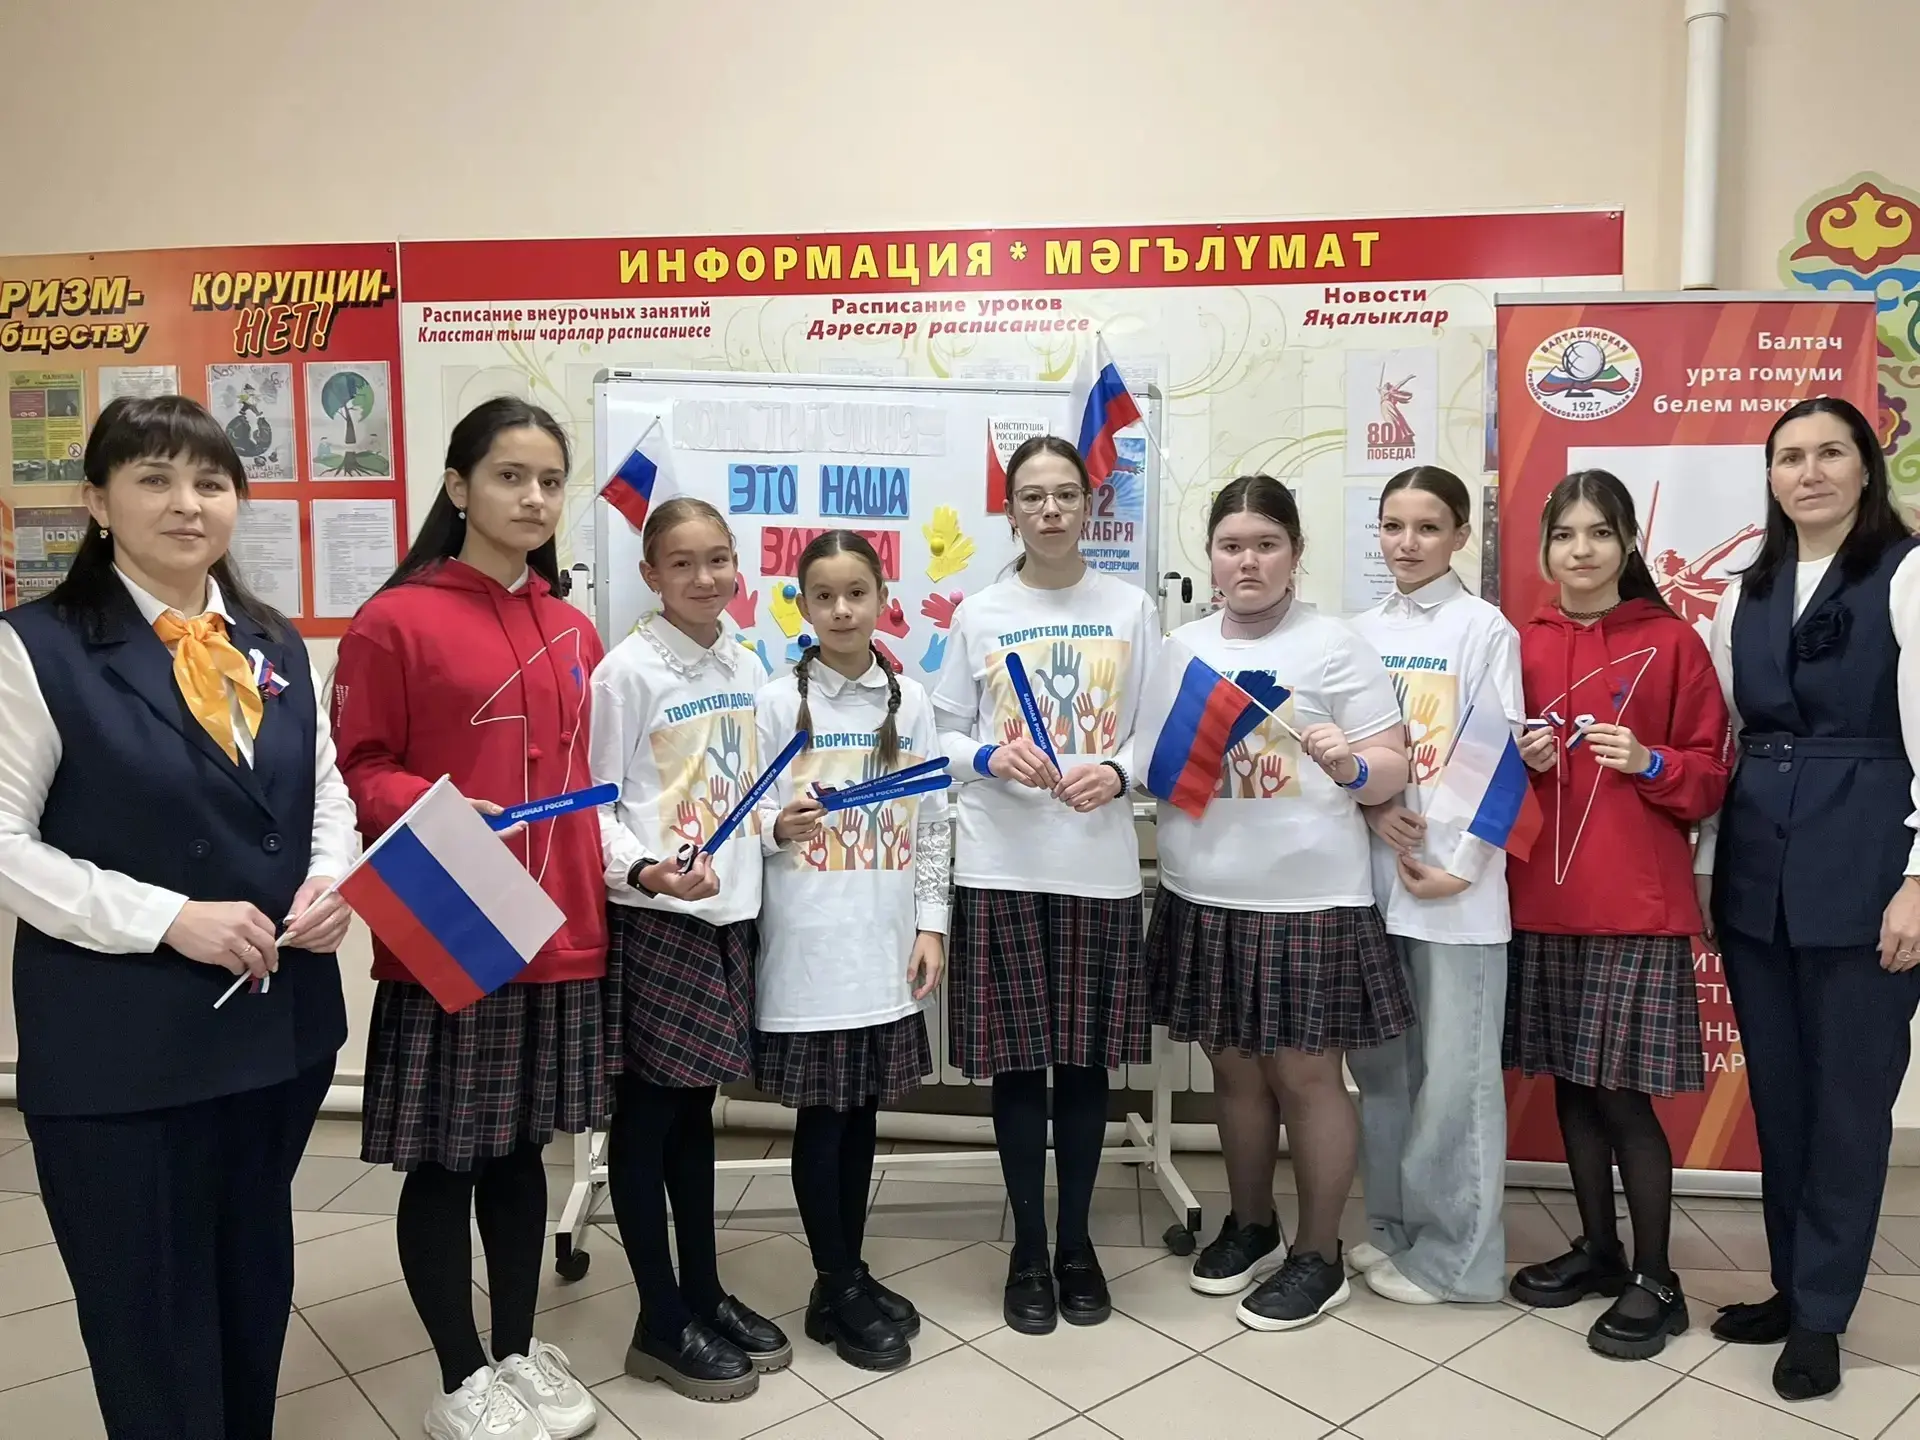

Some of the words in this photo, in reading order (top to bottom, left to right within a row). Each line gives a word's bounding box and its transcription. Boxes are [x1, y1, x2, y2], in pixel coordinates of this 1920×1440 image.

[618, 241, 993, 286] ИНФОРМАЦИЯ
[190, 269, 393, 308] КОРРУПЦИИ-
[1324, 287, 1427, 304] Новости
[422, 306, 523, 323] Расписание
[527, 304, 636, 325] внеурочных
[640, 301, 711, 319] занятий
[831, 297, 966, 315] Расписание
[977, 298, 1063, 316] уроков
[233, 301, 334, 354] НЕТ!
[806, 320, 918, 341] Дәресләр
[928, 317, 1090, 339] расписаниесе
[1303, 309, 1449, 329] Яңалыклар
[417, 327, 494, 343] Класстан
[496, 328, 536, 342] тыш
[539, 327, 605, 345] чаралар
[607, 325, 712, 344] расписаниесе
[1541, 330, 1629, 354] БАЛТАСИНСКАЯ
[1758, 331, 1842, 350] Балтач
[1686, 368, 1742, 387] урта
[1749, 367, 1842, 386] гомуми
[1572, 401, 1602, 412] 1927
[1653, 394, 1732, 413] белем
[994, 421, 1044, 431] КОНСТИТУЦИЯ
[1367, 422, 1394, 445] 80
[998, 442, 1020, 451] ФЕДЕР
[1367, 447, 1416, 461] ПОБЕДА!
[730, 464, 797, 515] ЭТО
[821, 464, 908, 516] НАША
[760, 526, 895, 580] ЗАА
[1099, 561, 1140, 571] ФЕДЕРАЦИИ
[998, 625, 1069, 647] ТВОРИТЕЛИ
[1071, 624, 1114, 639] ДОБРА
[1406, 656, 1448, 671] ДОБРА
[1023, 692, 1038, 722] ЕДИНАЯ
[753, 768, 777, 796] ЕДИНАЯ
[843, 793, 875, 803] ЕДИНАЯ
[875, 786, 905, 797] РОССИЯ
[511, 806, 544, 820] ЕДИНАЯ
[544, 798, 574, 812] РОССИЯ
